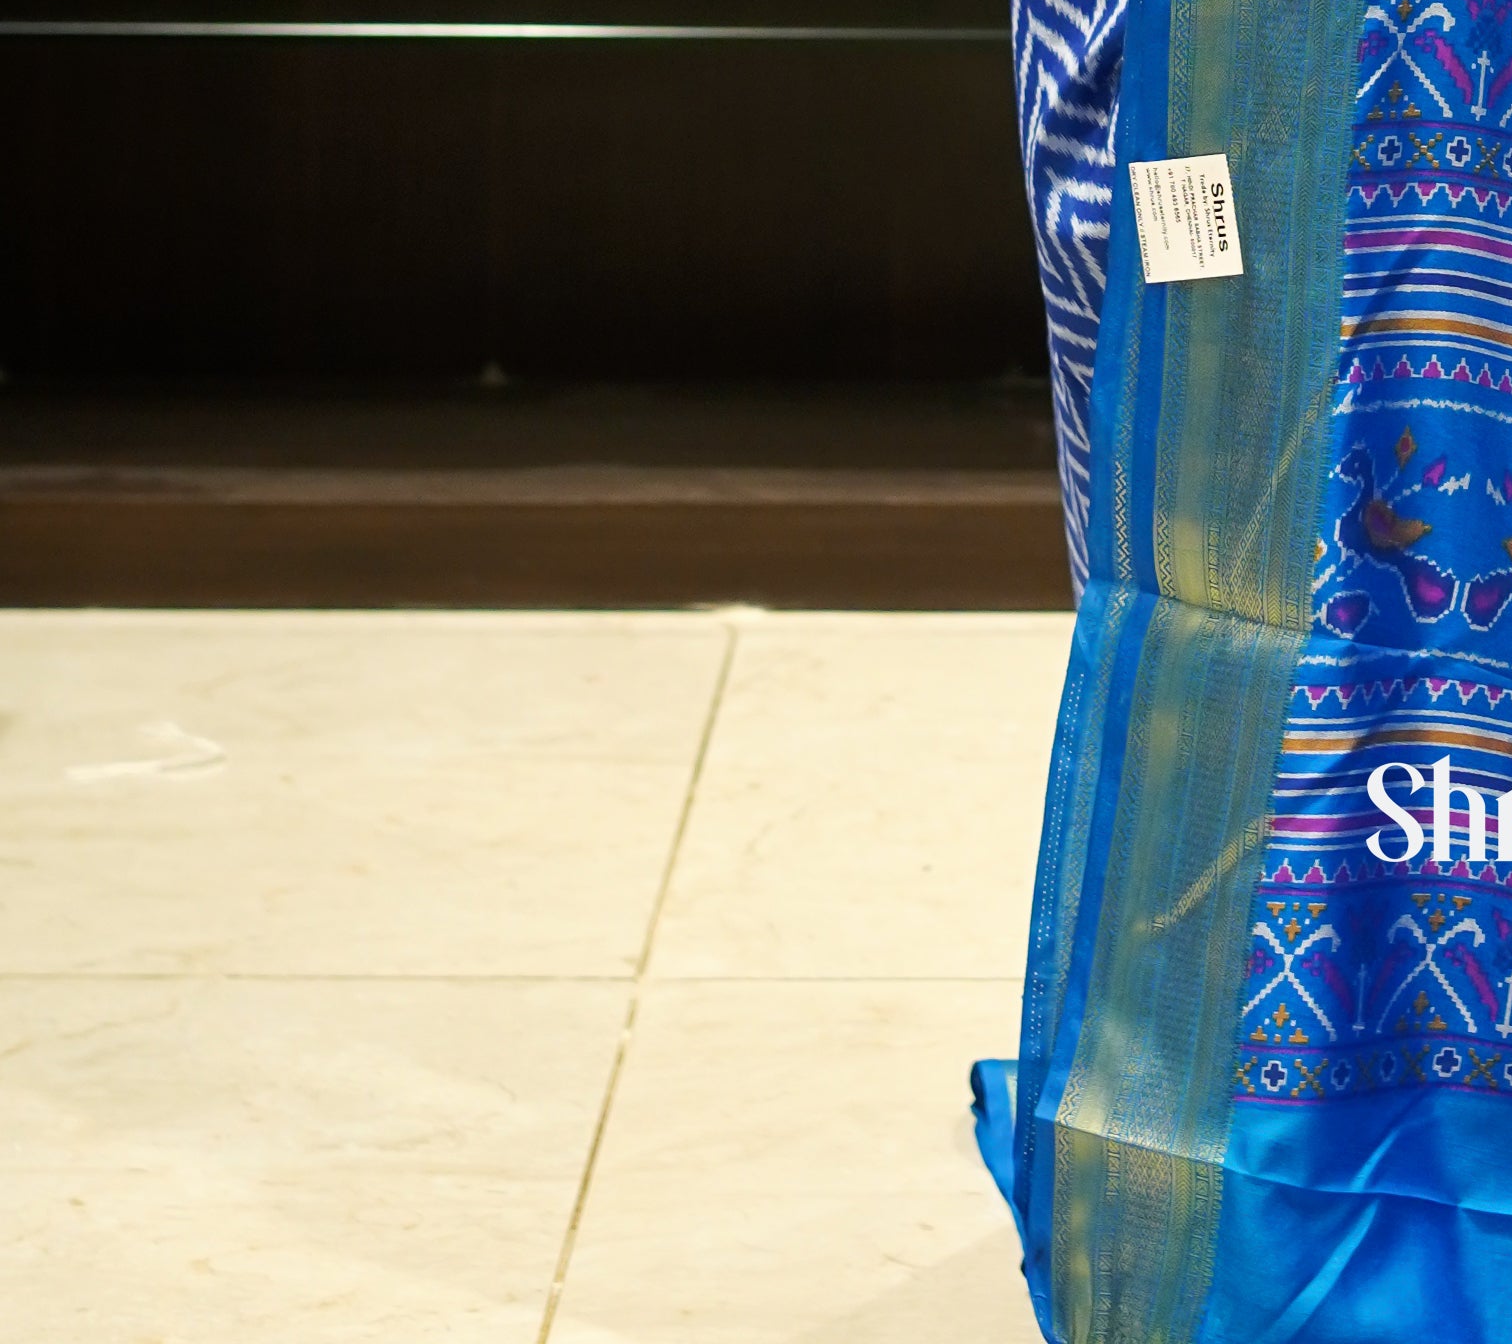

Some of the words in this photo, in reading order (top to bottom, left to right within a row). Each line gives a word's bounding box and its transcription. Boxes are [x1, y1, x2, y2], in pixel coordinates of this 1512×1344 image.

[1133, 182, 1141, 206] CLEAN
[1145, 167, 1157, 221] www.shrus.com
[1199, 173, 1207, 193] Trade
[1189, 192, 1198, 220] PRACHAR
[1204, 208, 1212, 226] Shrus
[1211, 182, 1228, 252] Shrus
[1140, 234, 1148, 258] STEAM
[1205, 229, 1216, 257] Eternity
[1143, 259, 1151, 277] IRON
